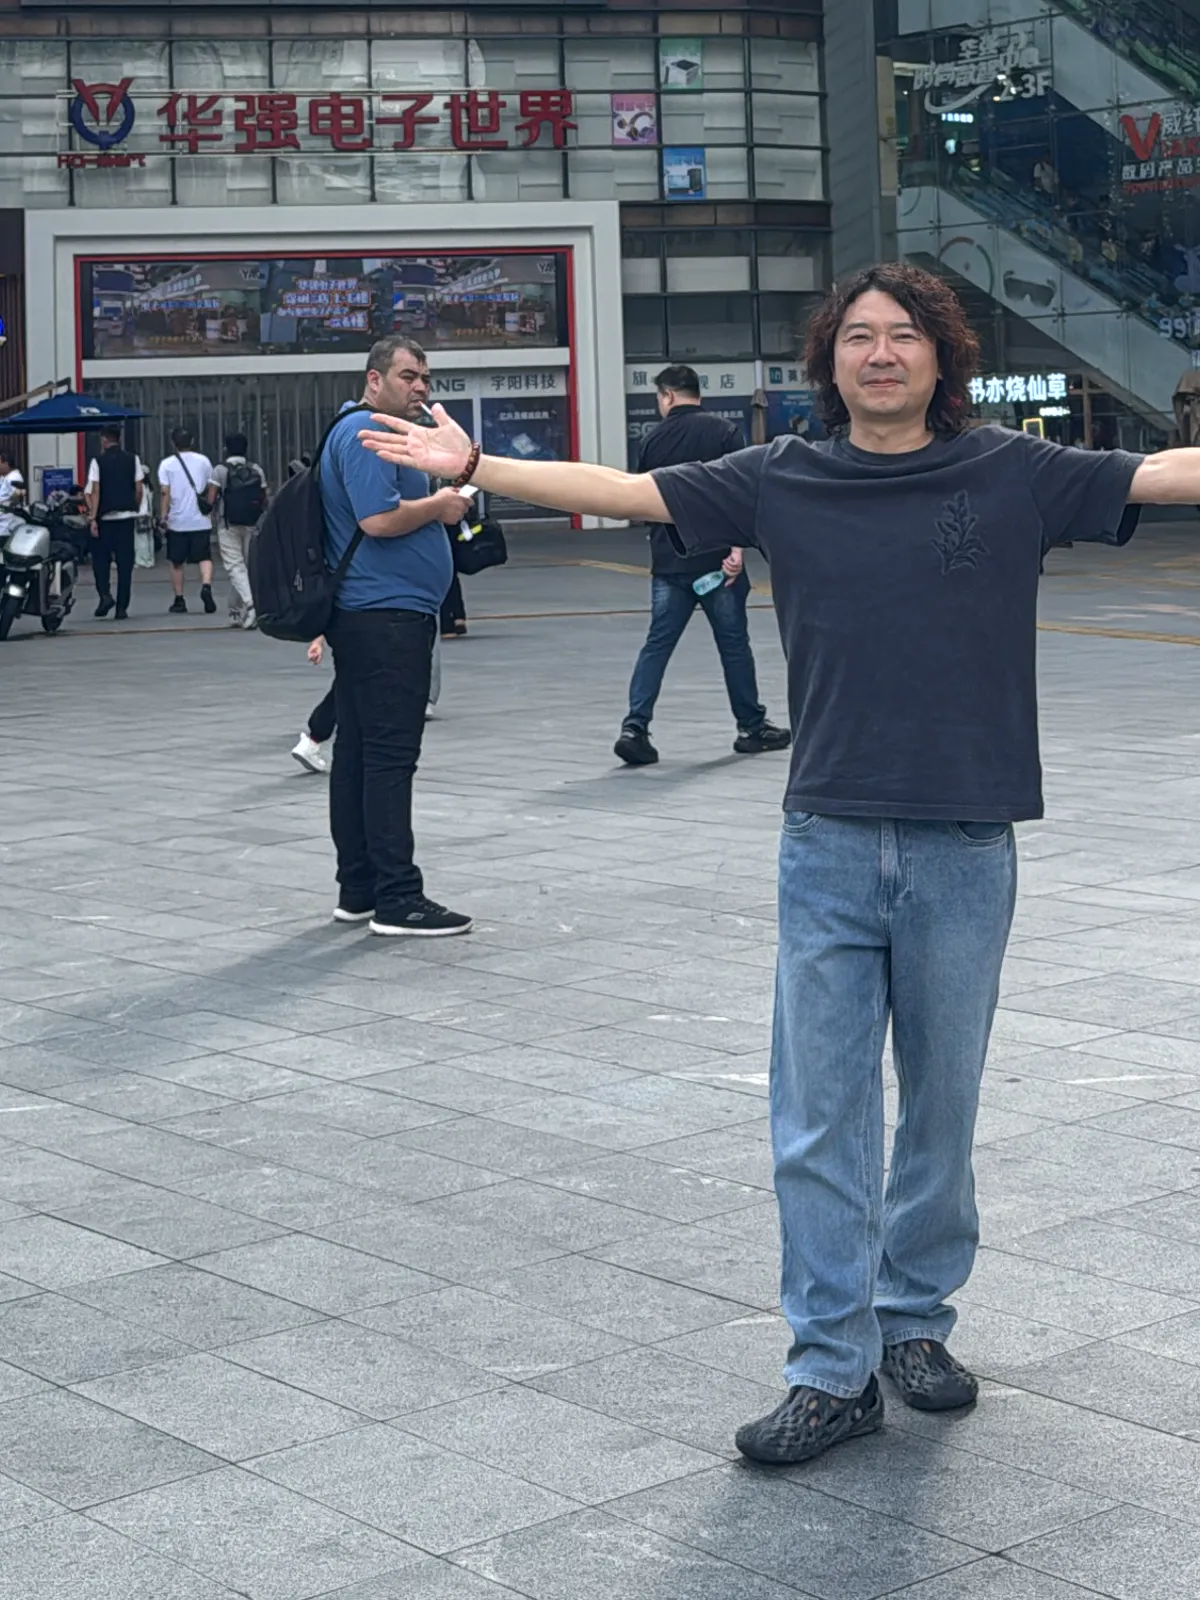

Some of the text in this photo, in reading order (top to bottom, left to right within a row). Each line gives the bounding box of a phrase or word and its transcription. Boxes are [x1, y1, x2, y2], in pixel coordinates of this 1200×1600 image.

[157, 89, 578, 152] 华强电子世界
[430, 378, 466, 392] NG
[491, 374, 557, 391] 宇阳科技
[965, 372, 1067, 405] 书亦烧仙草
